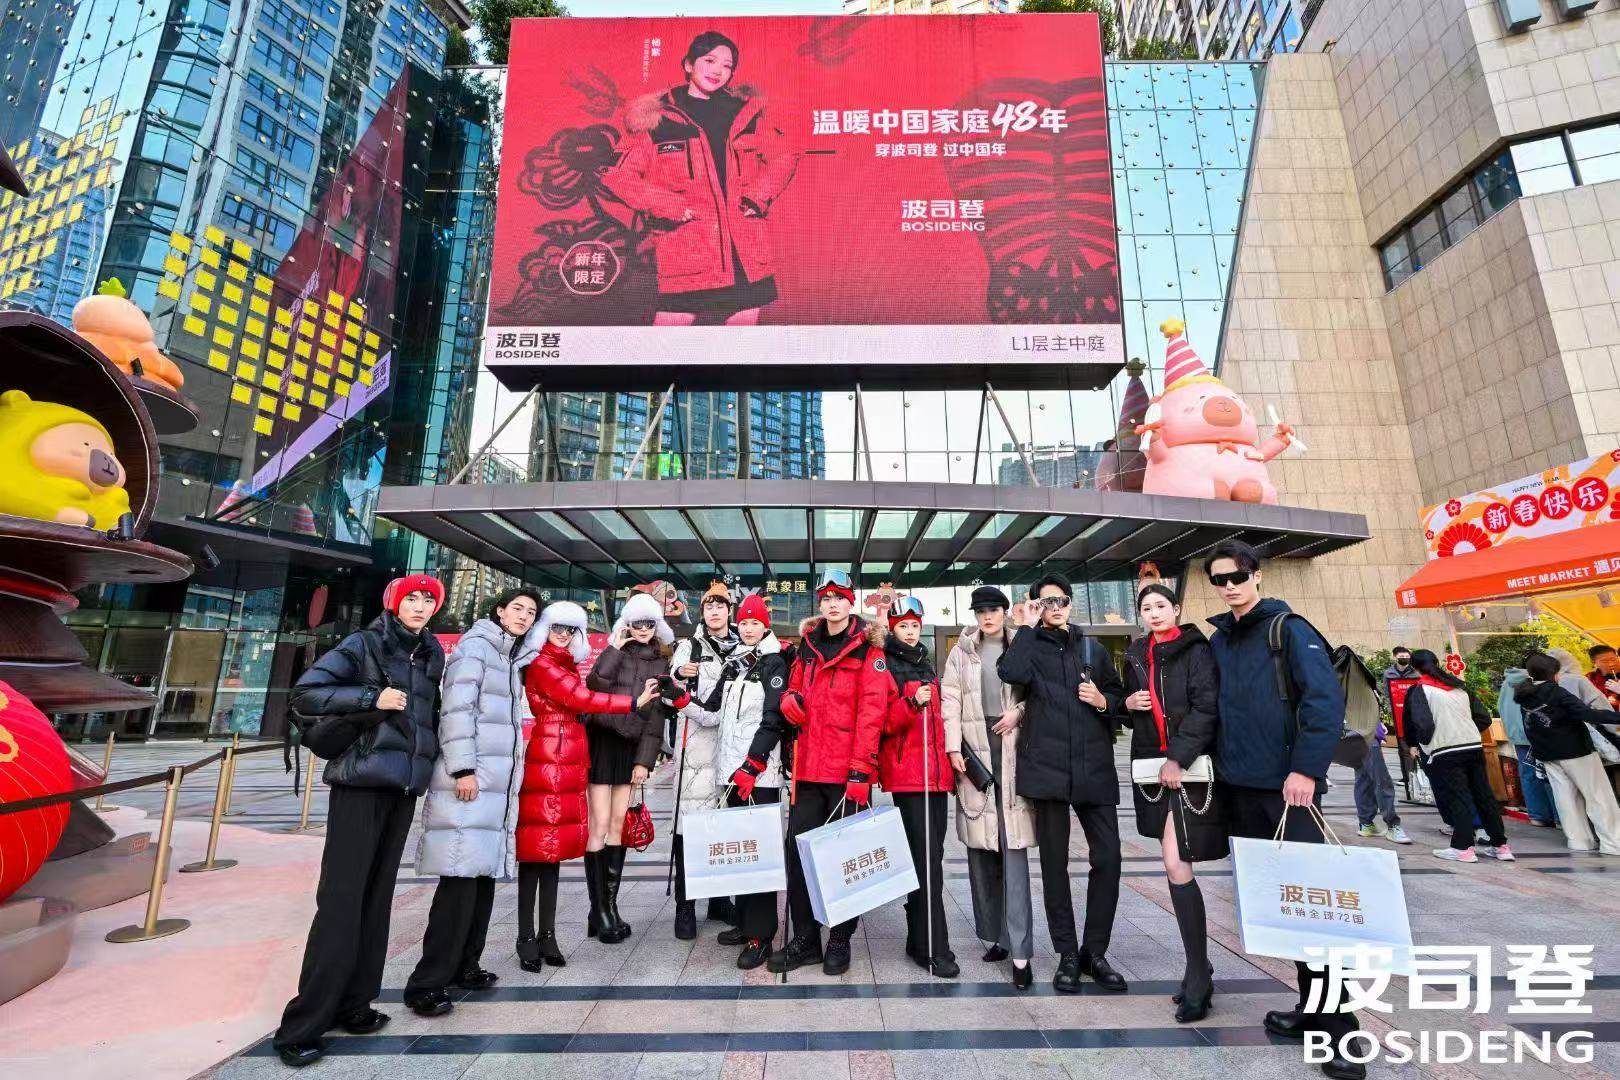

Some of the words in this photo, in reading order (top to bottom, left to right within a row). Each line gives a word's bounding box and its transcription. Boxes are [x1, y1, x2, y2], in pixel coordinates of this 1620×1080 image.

[812, 100, 1068, 138] 温暖中国家庭48年
[875, 143, 938, 157] 穿波司登
[943, 143, 1006, 157] 过中国年
[901, 200, 985, 219] 波司登
[901, 221, 985, 232] BOSIDENG
[575, 252, 606, 266] 新年
[574, 270, 605, 284] 限定
[496, 333, 560, 348] 波司登
[1012, 335, 1105, 352] L1层主中庭
[495, 350, 560, 359] BOSIDENG
[1486, 480, 1604, 530] 新春快乐
[766, 580, 807, 593] 萬象匯
[1507, 576, 1537, 589] MEET
[1539, 567, 1590, 584] MARKET
[709, 839, 758, 857] 波司登
[841, 846, 889, 876] 波司登
[1280, 884, 1362, 911] 波司登
[1281, 906, 1365, 925] 畅销全球72国
